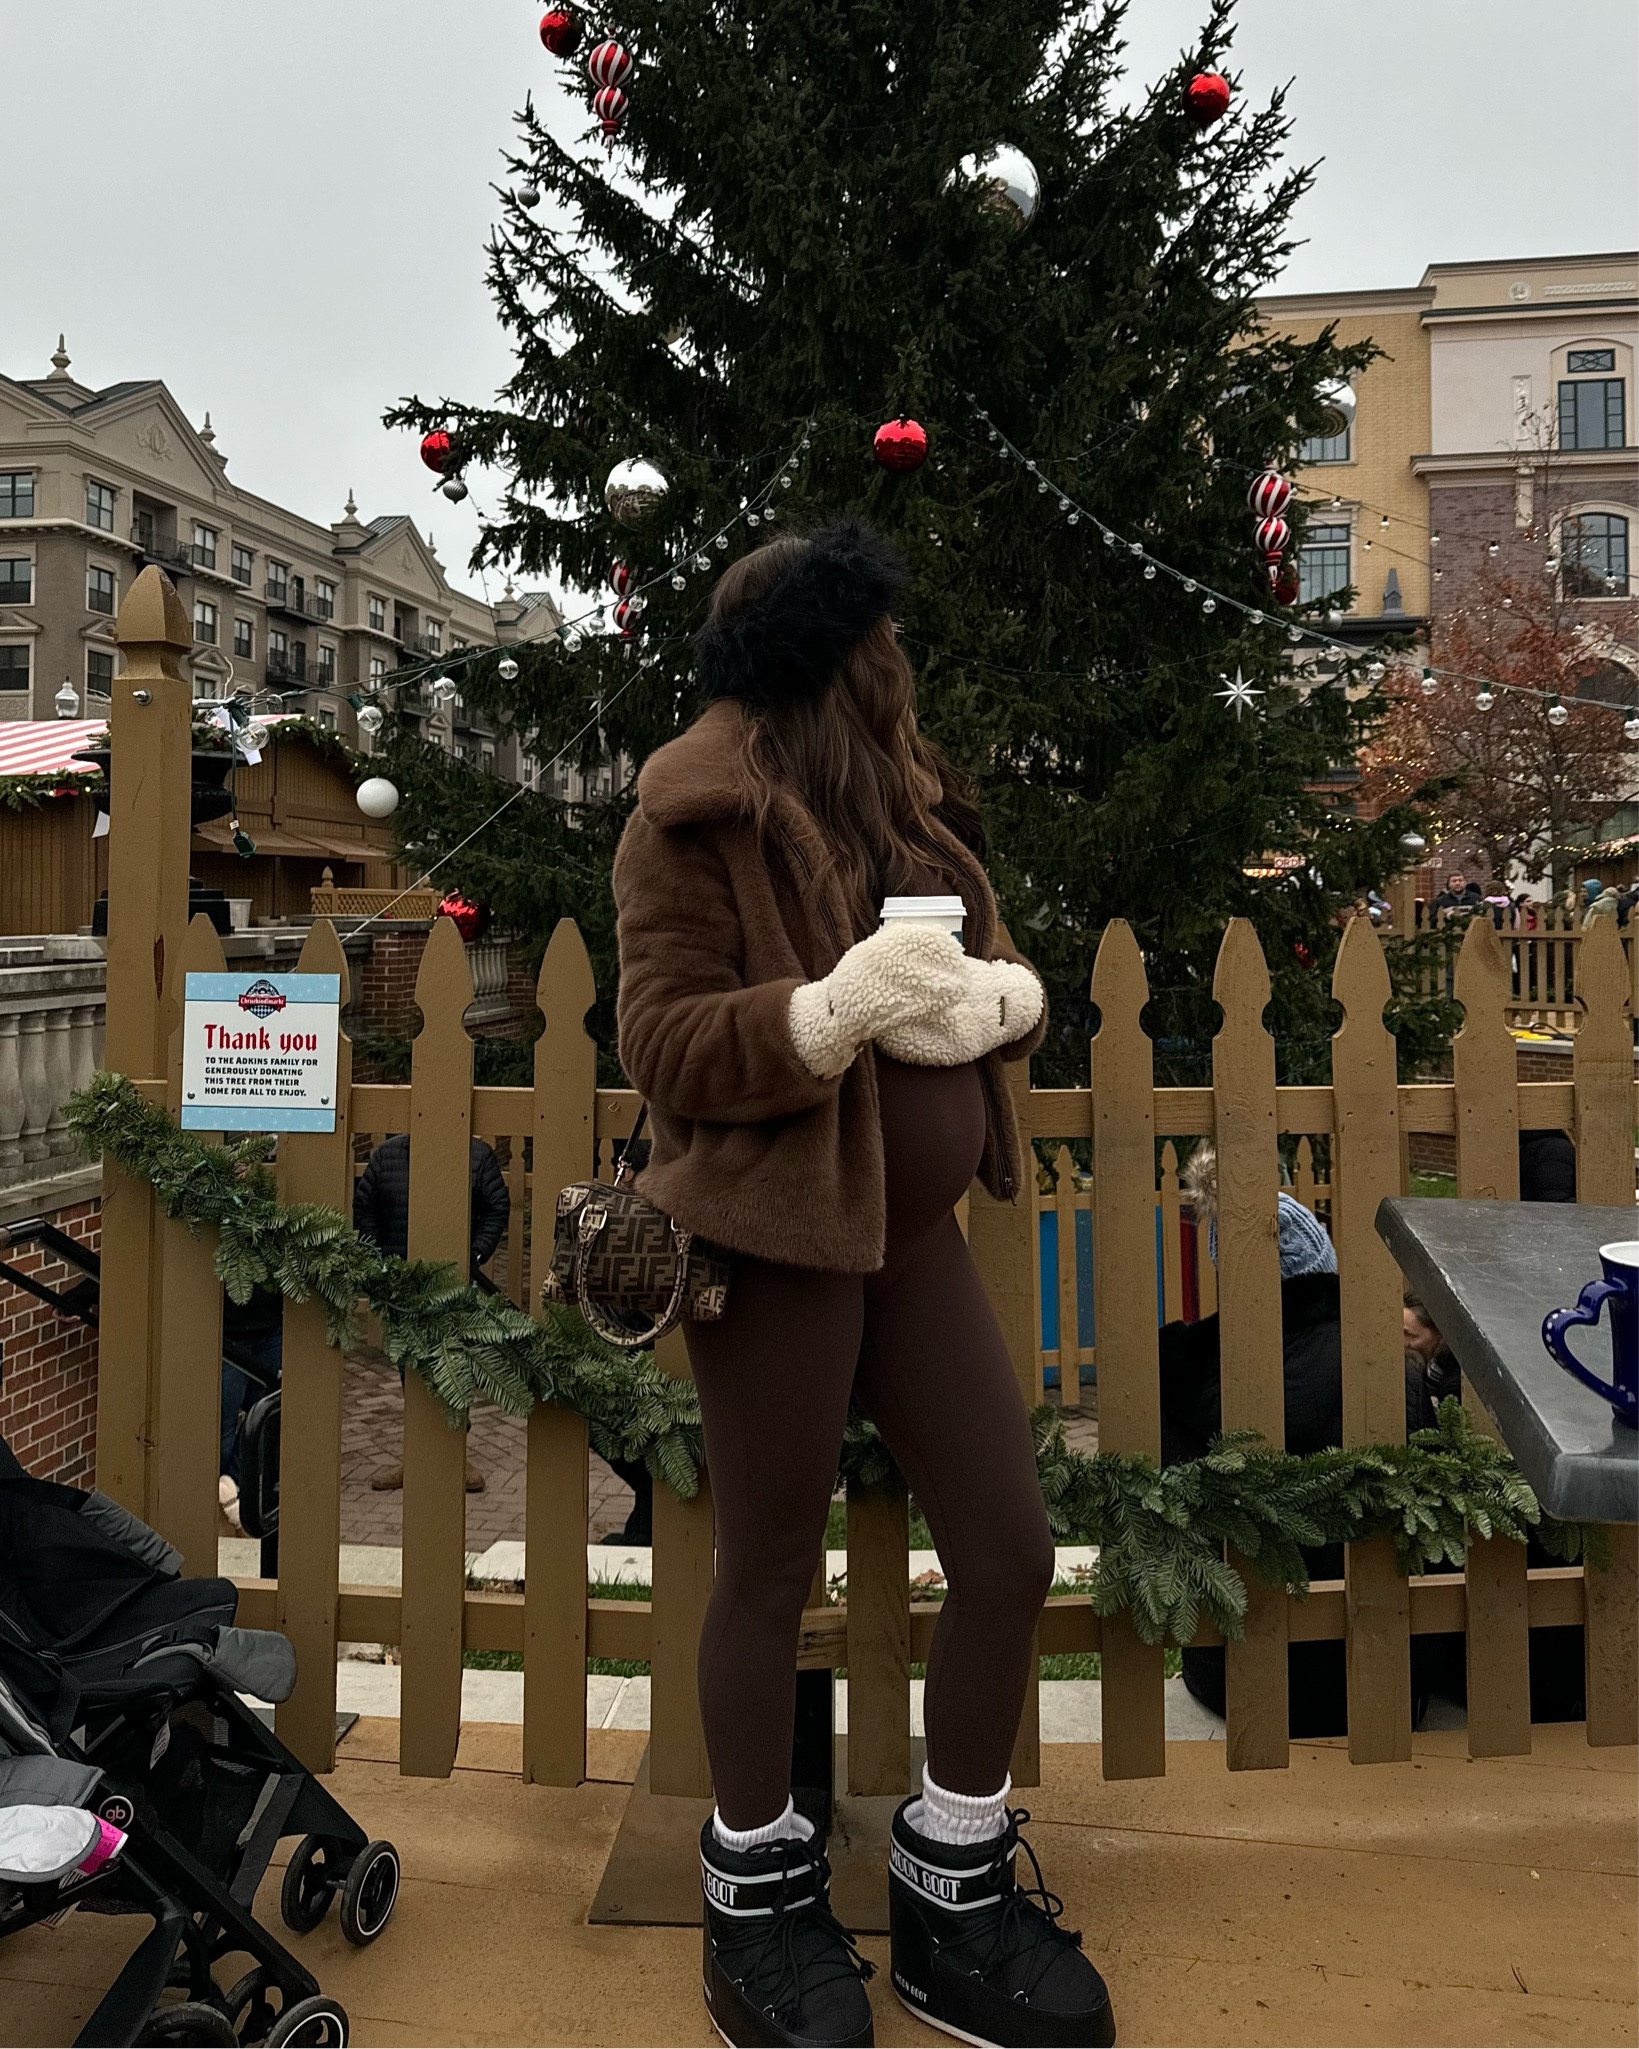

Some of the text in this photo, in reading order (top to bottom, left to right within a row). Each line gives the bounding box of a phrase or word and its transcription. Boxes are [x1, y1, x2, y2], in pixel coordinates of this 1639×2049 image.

[204, 1024, 317, 1055] Thank you
[236, 1057, 268, 1065] ADKINS
[271, 1058, 300, 1066] FAMILY
[205, 1067, 303, 1076] GENEROUSLY DONATING
[205, 1077, 224, 1085] THIS
[248, 1078, 271, 1086] FROM
[205, 1087, 228, 1095] HOME
[279, 1089, 307, 1097] ENJOY.
[105, 1805, 126, 1822] gb
[890, 1844, 960, 1902] MOON BOOT
[707, 1872, 738, 1906] BOOT
